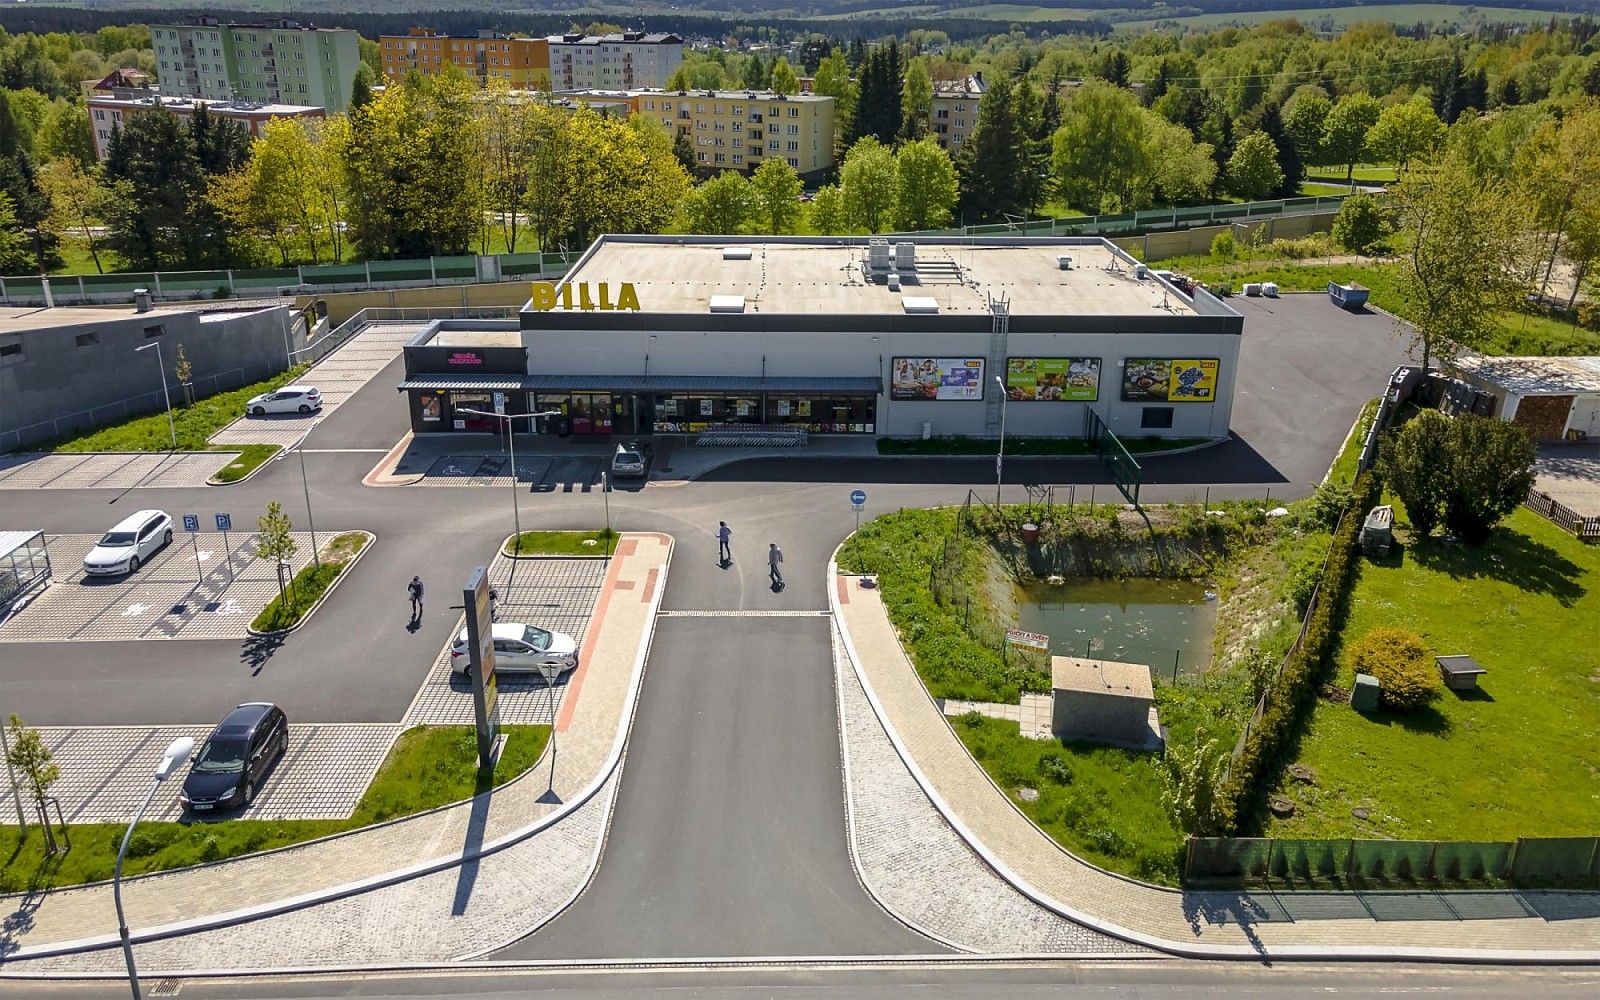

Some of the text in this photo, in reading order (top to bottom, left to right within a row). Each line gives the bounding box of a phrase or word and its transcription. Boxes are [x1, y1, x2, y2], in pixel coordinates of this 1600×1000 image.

[532, 281, 641, 311] BILLA
[185, 518, 193, 527] P
[218, 517, 225, 526] P
